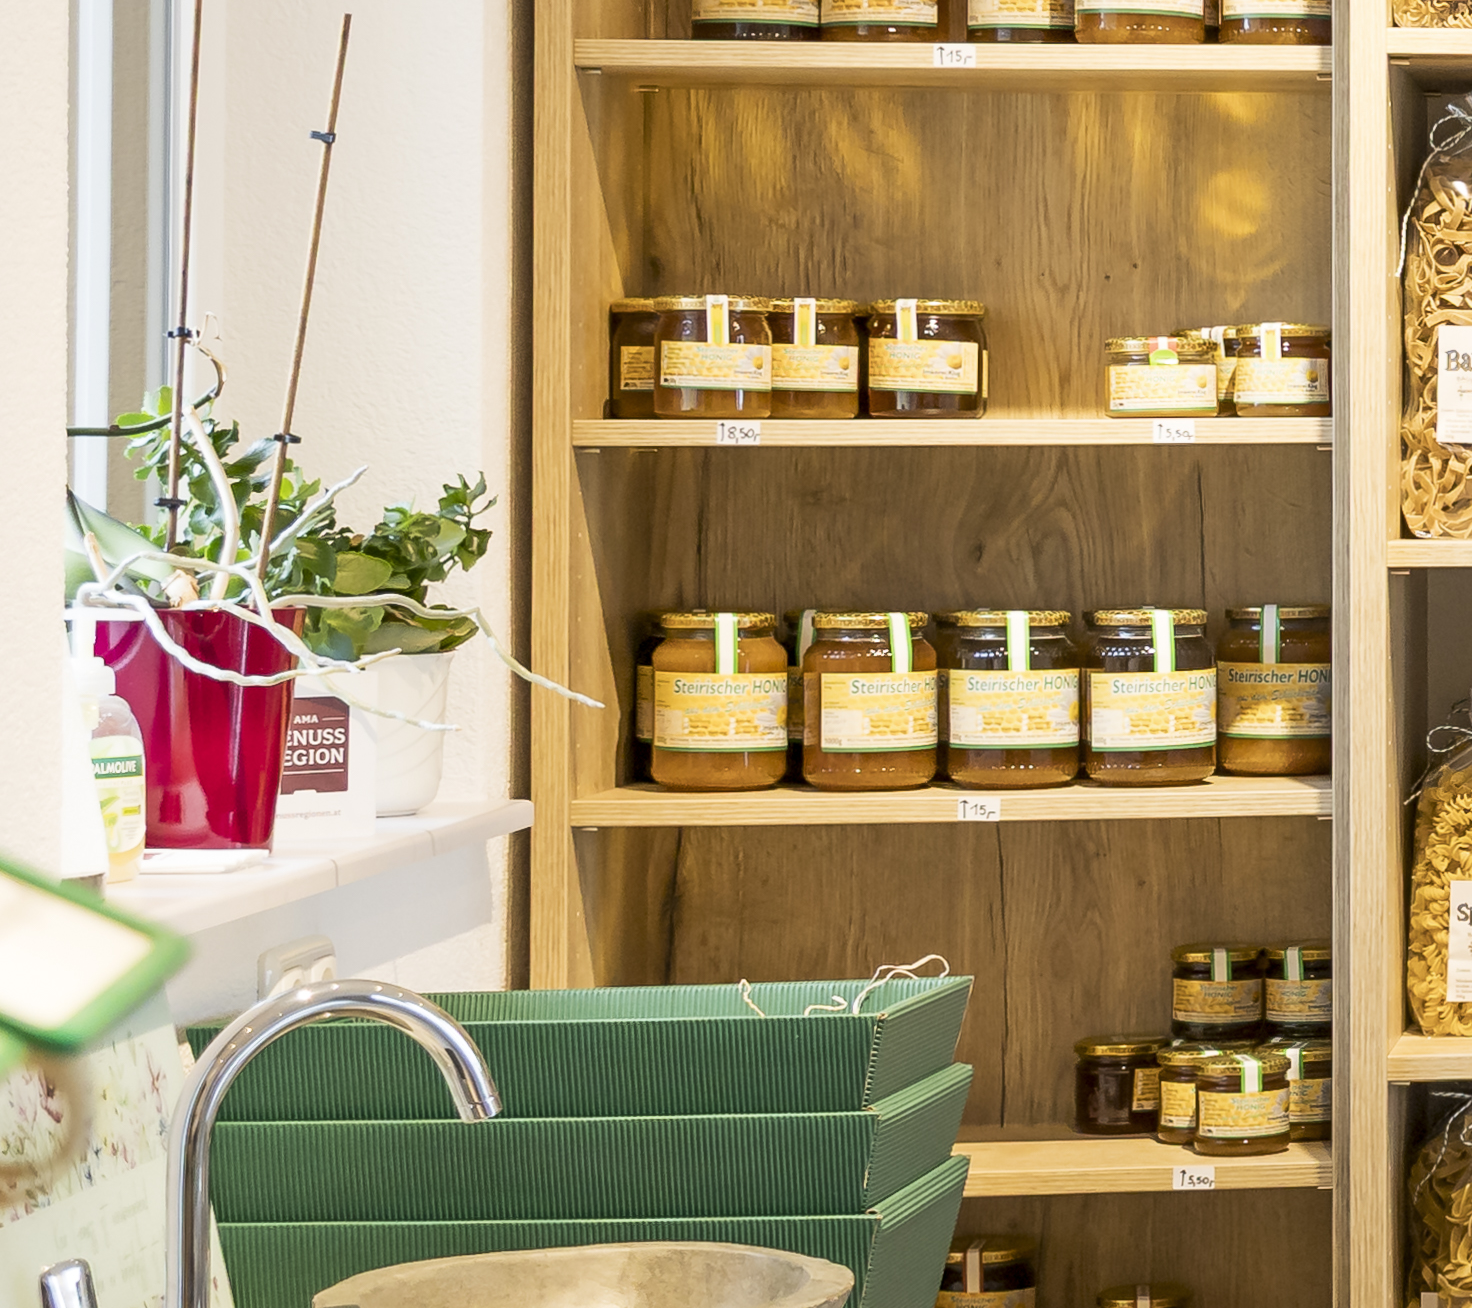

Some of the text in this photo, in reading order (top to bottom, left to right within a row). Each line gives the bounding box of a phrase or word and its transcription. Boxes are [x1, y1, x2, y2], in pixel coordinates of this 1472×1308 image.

[966, 675, 1039, 693] Steirischer
[1112, 676, 1184, 695] Steirischer
[1227, 667, 1331, 686] Steirischer HONI
[673, 678, 749, 697] Steirischer
[851, 679, 921, 697] Steirischer
[293, 714, 319, 725] AMA
[286, 727, 346, 747] ENUSS
[283, 748, 345, 767] EGION
